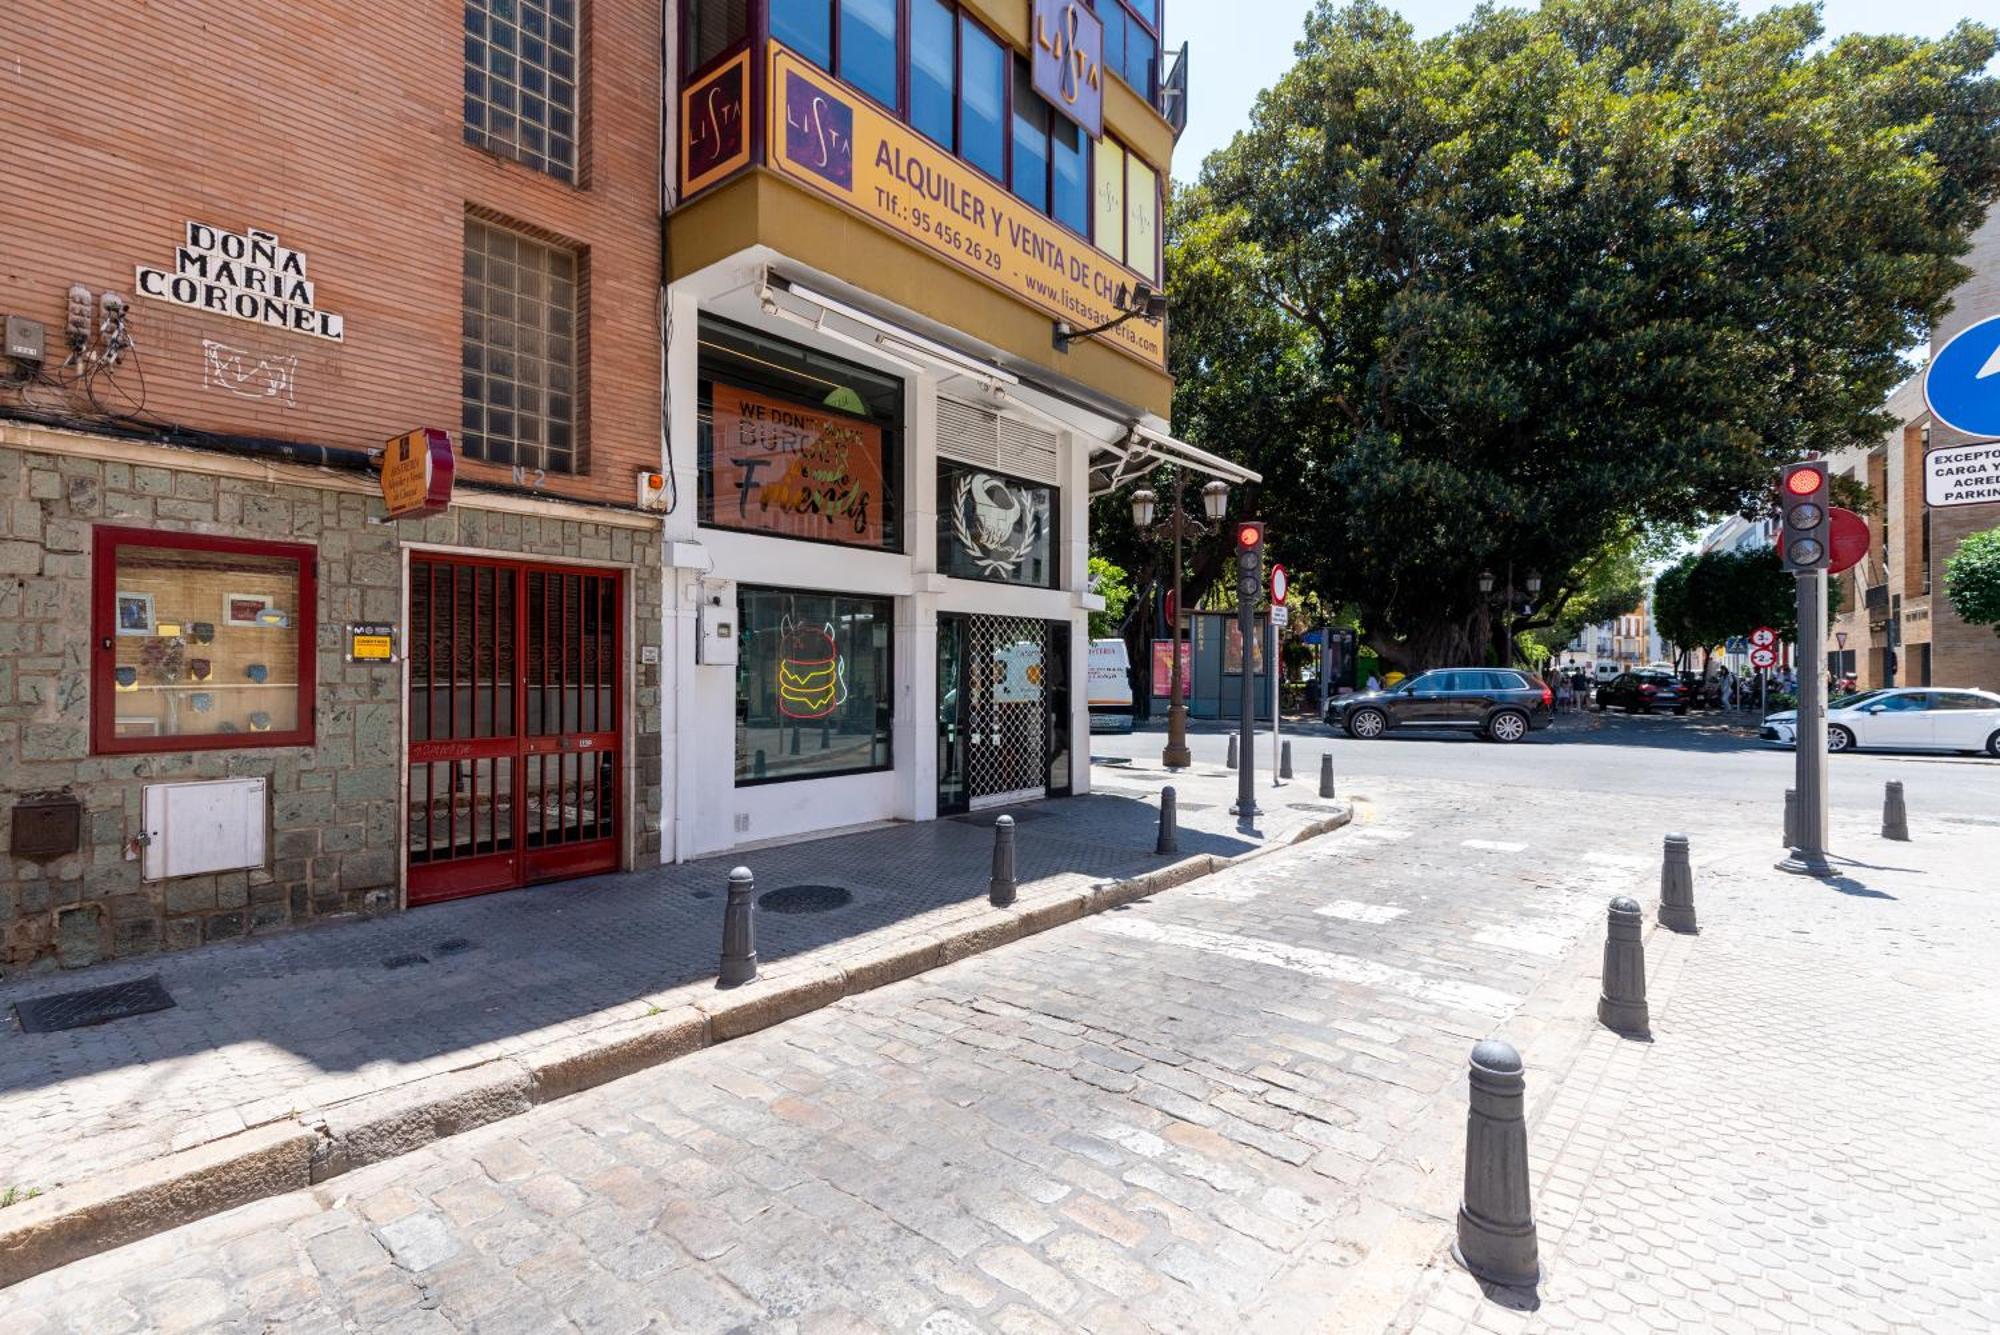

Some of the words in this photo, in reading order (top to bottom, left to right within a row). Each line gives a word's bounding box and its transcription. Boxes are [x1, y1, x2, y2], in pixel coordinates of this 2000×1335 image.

[690, 87, 741, 160] LISTA
[787, 97, 852, 168] LISTA
[874, 186, 908, 221] Tlf.:
[912, 207, 931, 233] 95
[934, 221, 962, 250] 456
[965, 237, 982, 261] 26
[985, 248, 1001, 271] 29
[875, 139, 986, 230] ALQUILER
[991, 205, 1004, 238] Y
[1008, 217, 1065, 275] VENTA
[1070, 255, 1090, 289] DE
[179, 249, 311, 305] MARIA
[190, 223, 304, 277] DOÑA
[139, 269, 342, 339] CORONEL
[739, 401, 766, 421] WE
[534, 469, 545, 488] 2
[1934, 449, 2000, 465] EXCEPTO
[1935, 463, 1987, 477] CARGA
[1992, 462, 2000, 471] Y
[1945, 489, 2000, 501] PARKIN
